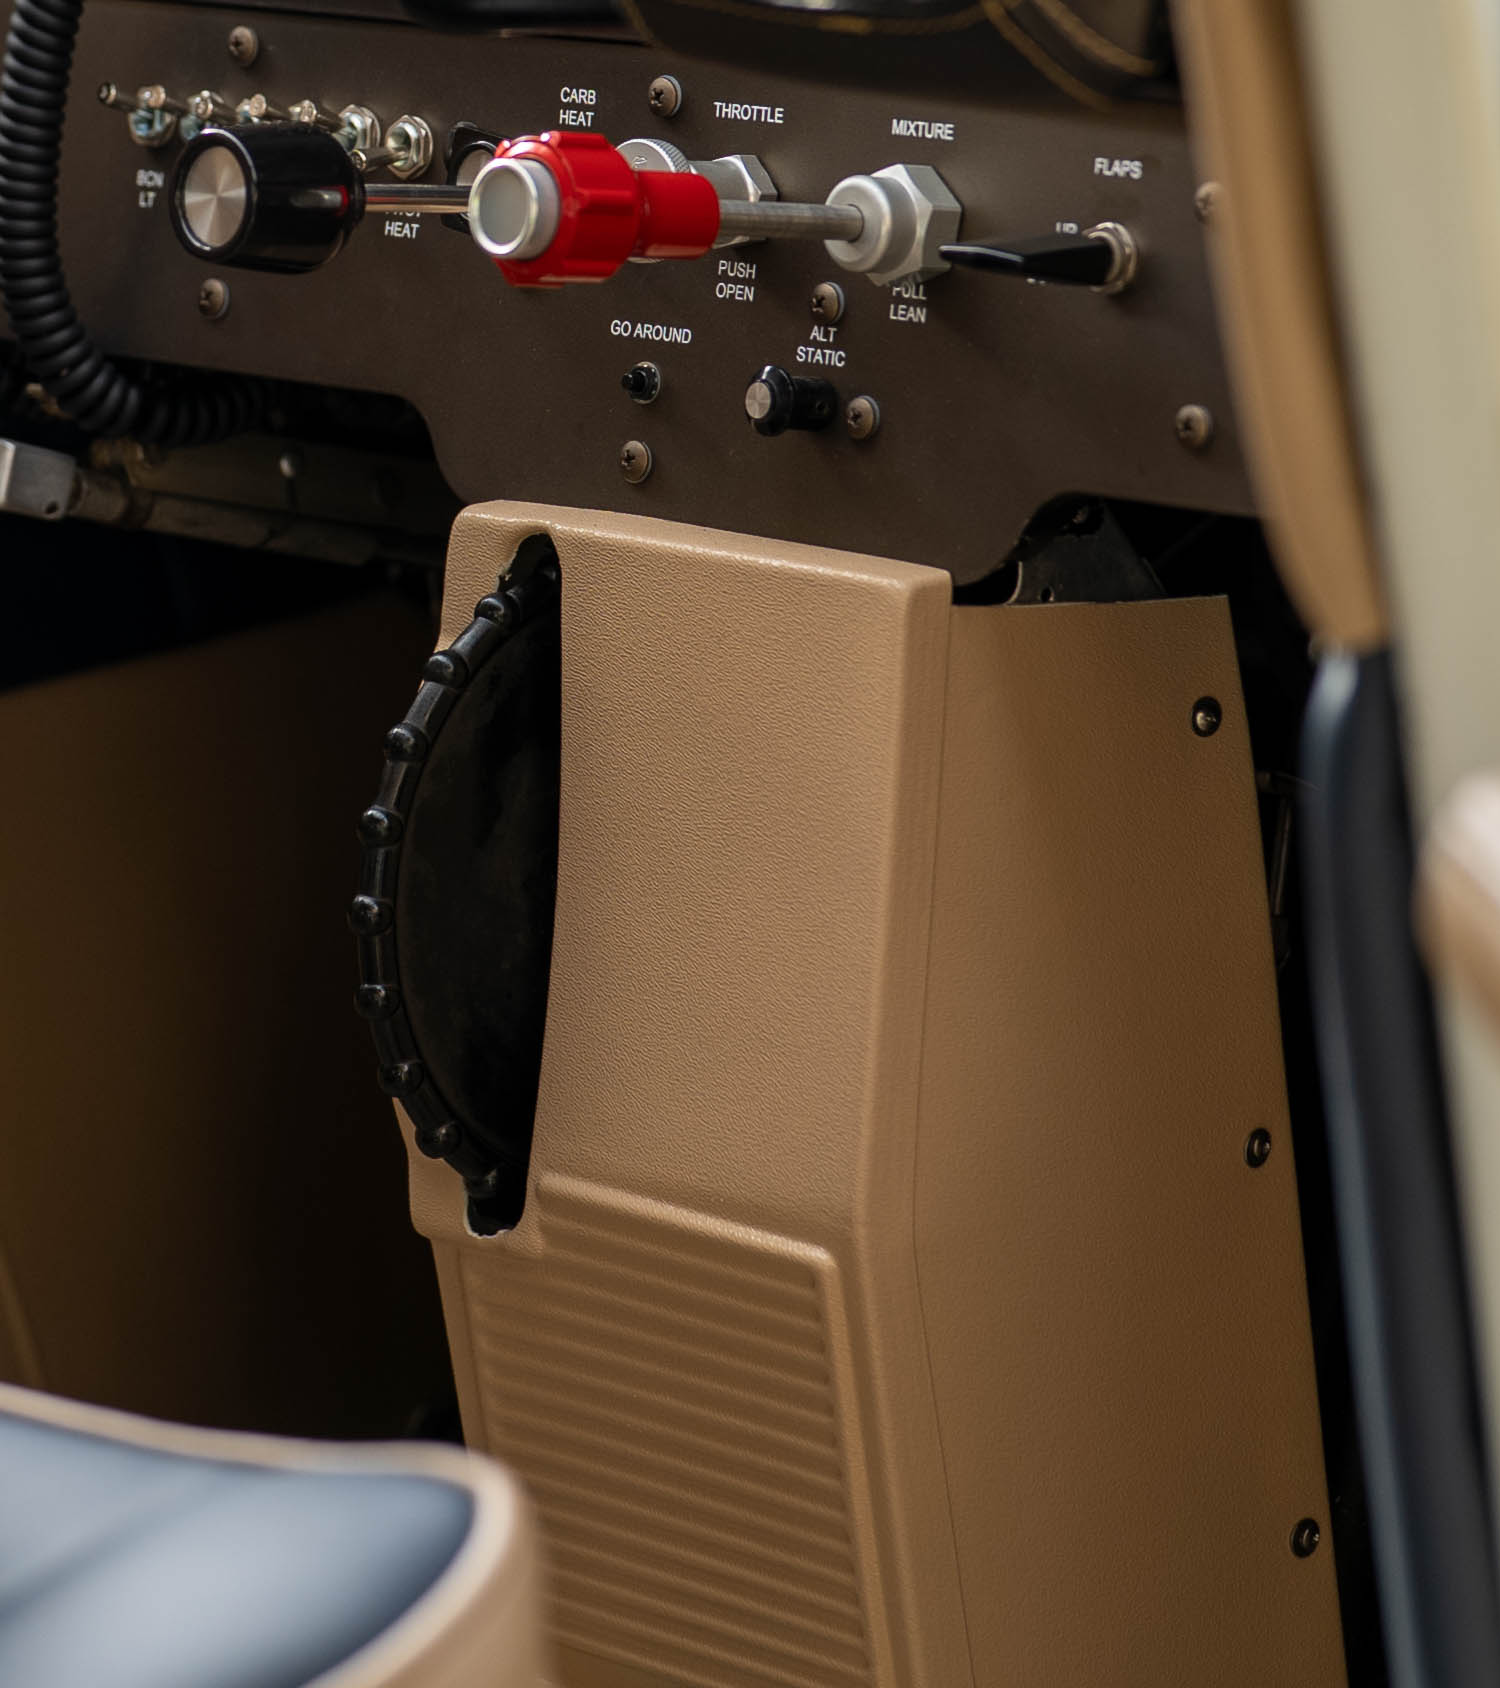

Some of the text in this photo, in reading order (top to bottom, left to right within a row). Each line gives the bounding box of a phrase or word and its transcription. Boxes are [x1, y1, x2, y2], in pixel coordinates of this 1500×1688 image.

[560, 86, 597, 105] CARB
[559, 109, 595, 128] HEAT
[713, 101, 785, 124] THROTTLE
[891, 118, 955, 141] MIXTURE
[1094, 157, 1144, 180] FLAPS
[384, 219, 421, 240] HEAT
[718, 260, 757, 280] PUSH
[715, 282, 755, 302] OPEN
[889, 303, 927, 324] LEAN
[610, 319, 693, 345] GO AROUND
[810, 325, 838, 343] ALT
[796, 346, 847, 368] STATIC
